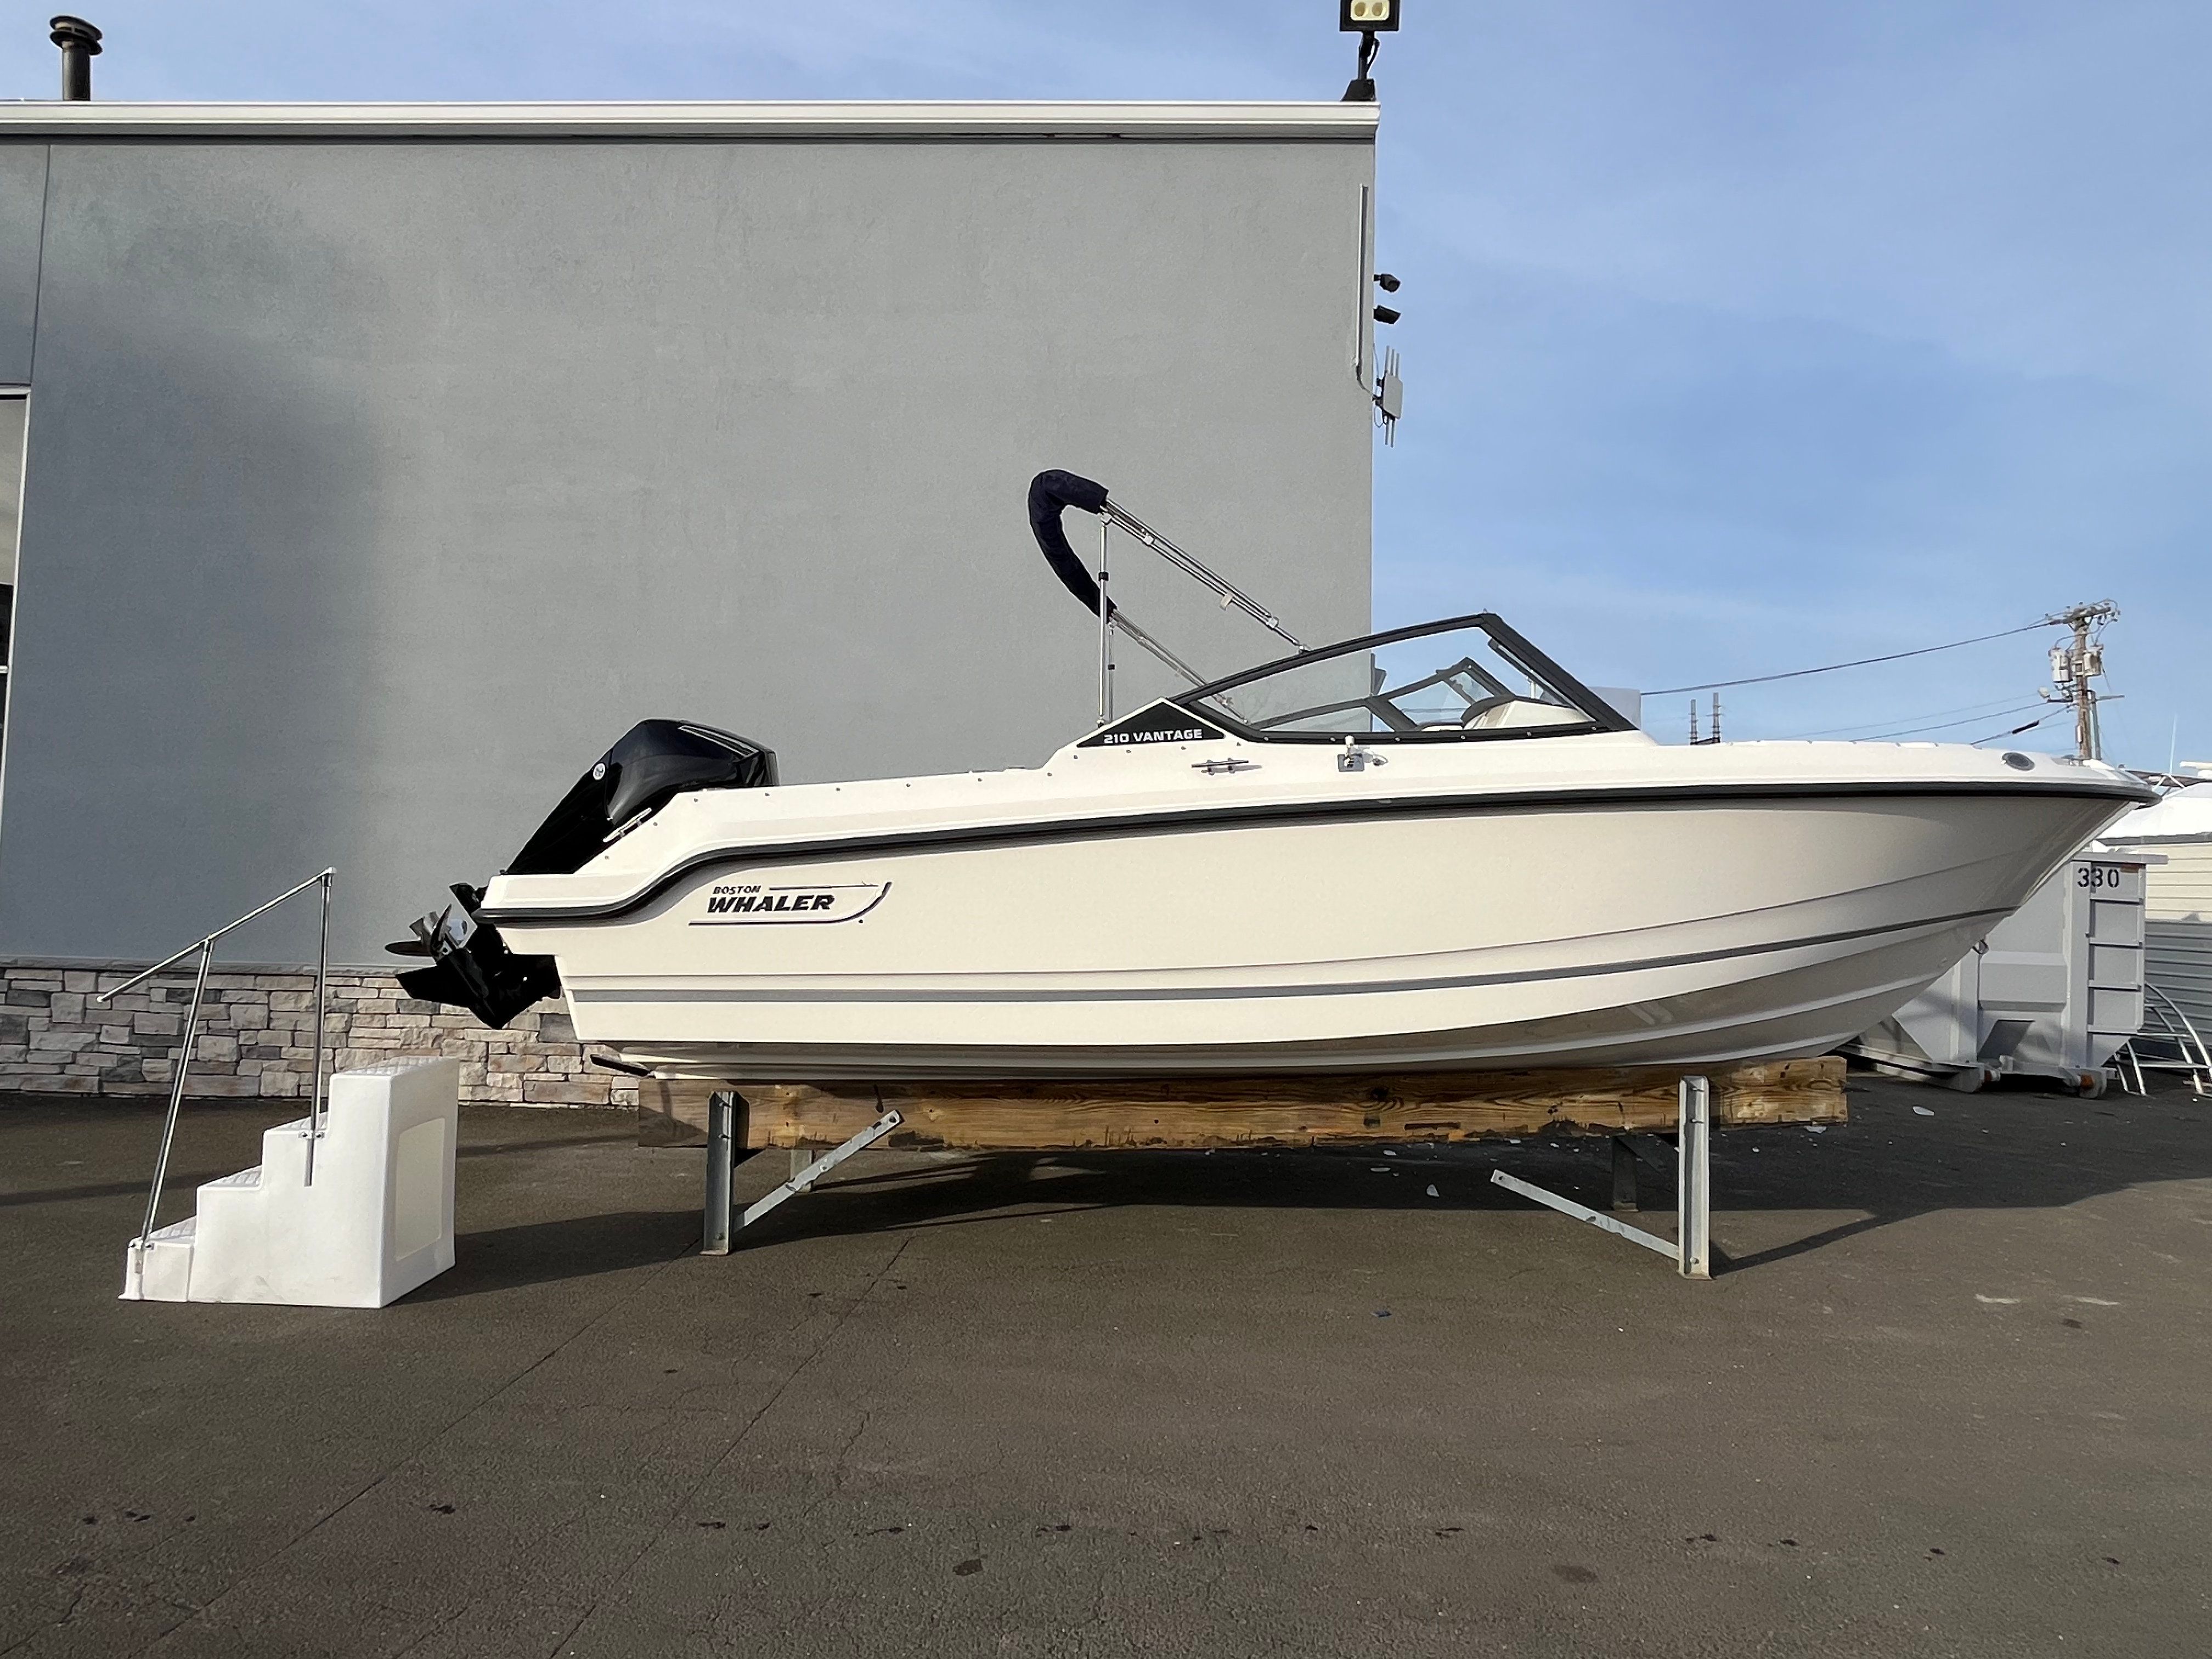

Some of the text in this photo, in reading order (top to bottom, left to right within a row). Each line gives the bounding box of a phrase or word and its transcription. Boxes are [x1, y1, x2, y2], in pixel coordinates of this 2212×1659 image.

[1103, 729, 1203, 744] 210 VANTAGE
[2077, 868, 2120, 887] 330
[713, 885, 761, 894] BOSTON
[707, 894, 835, 913] WHALER
